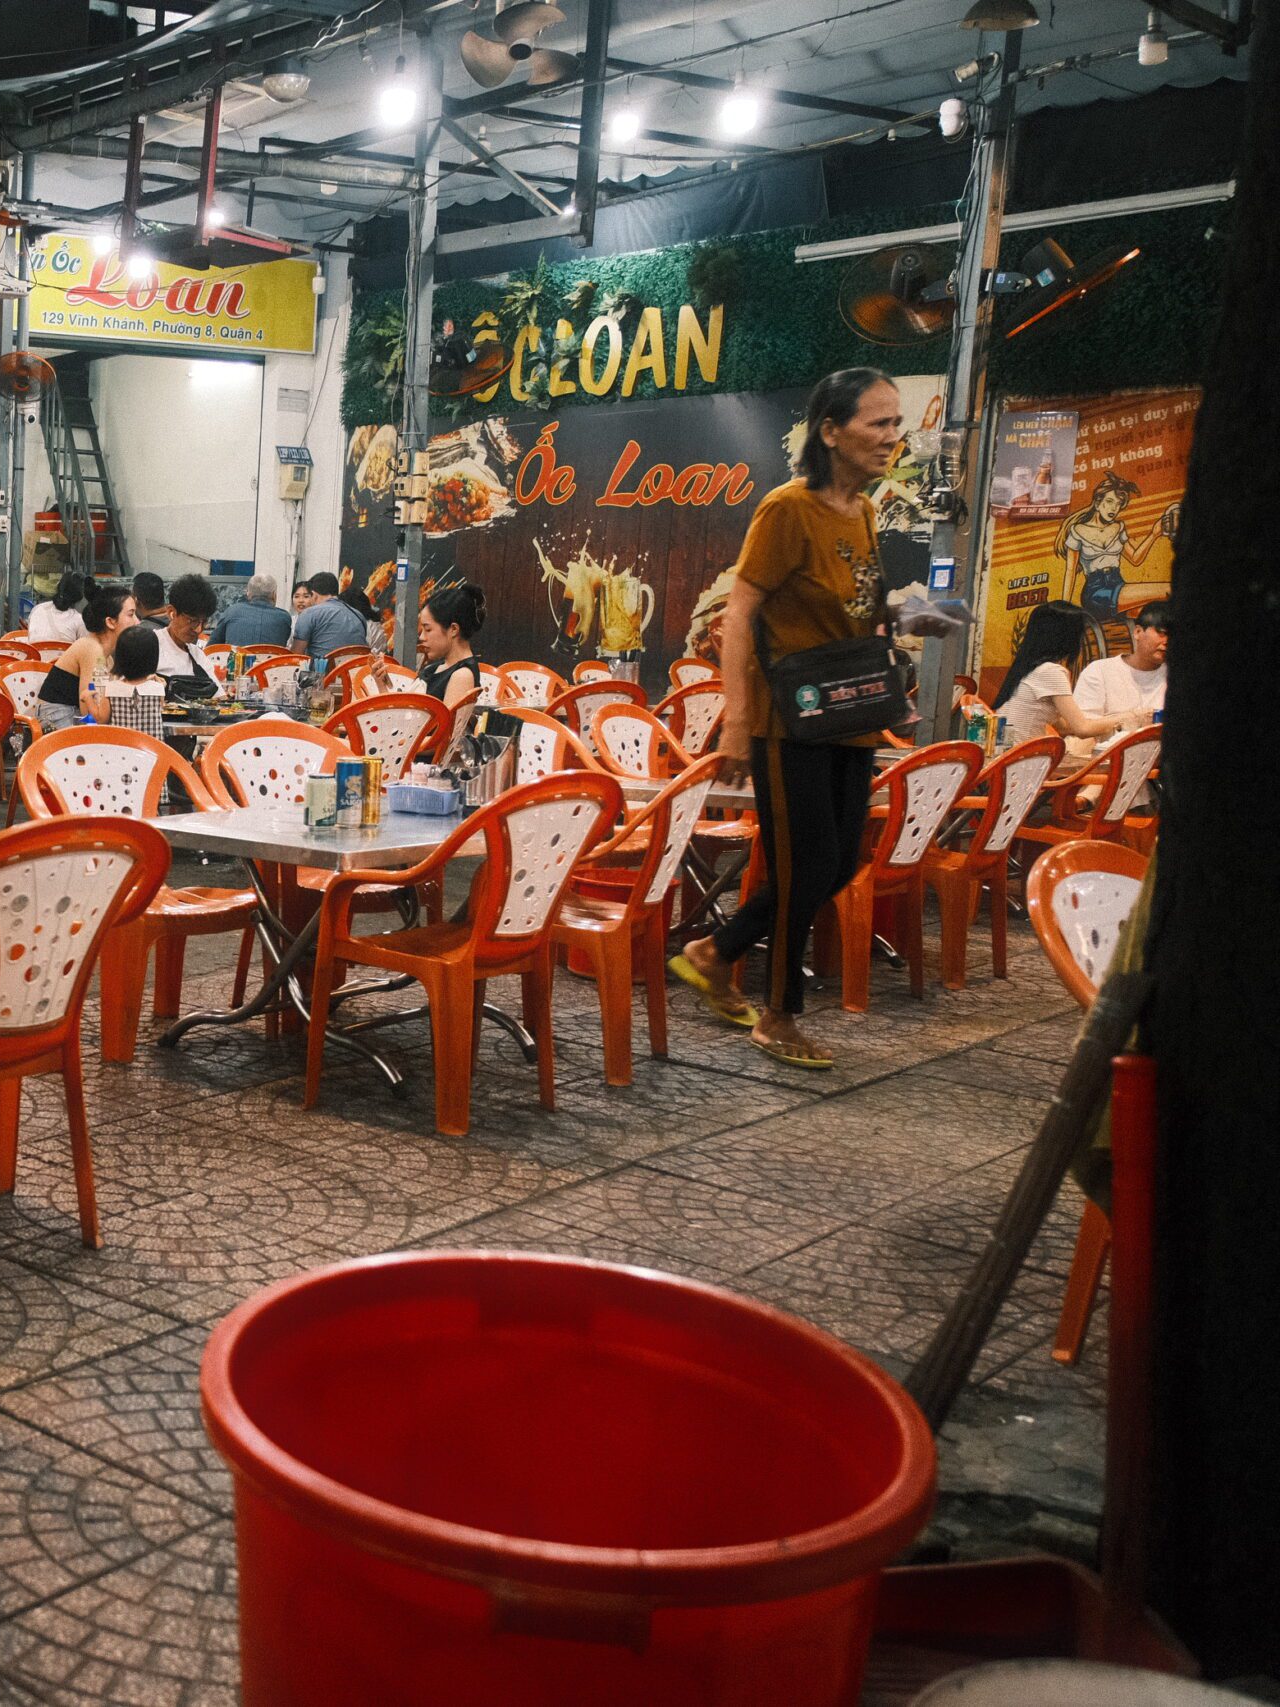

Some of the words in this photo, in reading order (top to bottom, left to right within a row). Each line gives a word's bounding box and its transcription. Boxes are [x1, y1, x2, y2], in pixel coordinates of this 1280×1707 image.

[51, 241, 81, 274] Ốc
[65, 251, 251, 320] Loan
[41, 312, 64, 325] 129
[69, 313, 98, 327] Vĩnh
[103, 315, 148, 332] Khánh,
[153, 320, 201, 338] Phường
[205, 325, 215, 338] 8,
[220, 326, 252, 341] Quận
[255, 329, 263, 341] 4
[549, 304, 724, 398] LOAN
[1094, 415, 1116, 434] tồn
[1119, 413, 1139, 429] tại
[515, 420, 577, 506] Ốc
[595, 440, 754, 508] Loan
[1091, 455, 1115, 471] hay
[1120, 443, 1163, 463] không
[1008, 577, 1029, 590] LIFE
[1031, 573, 1049, 586] FOR
